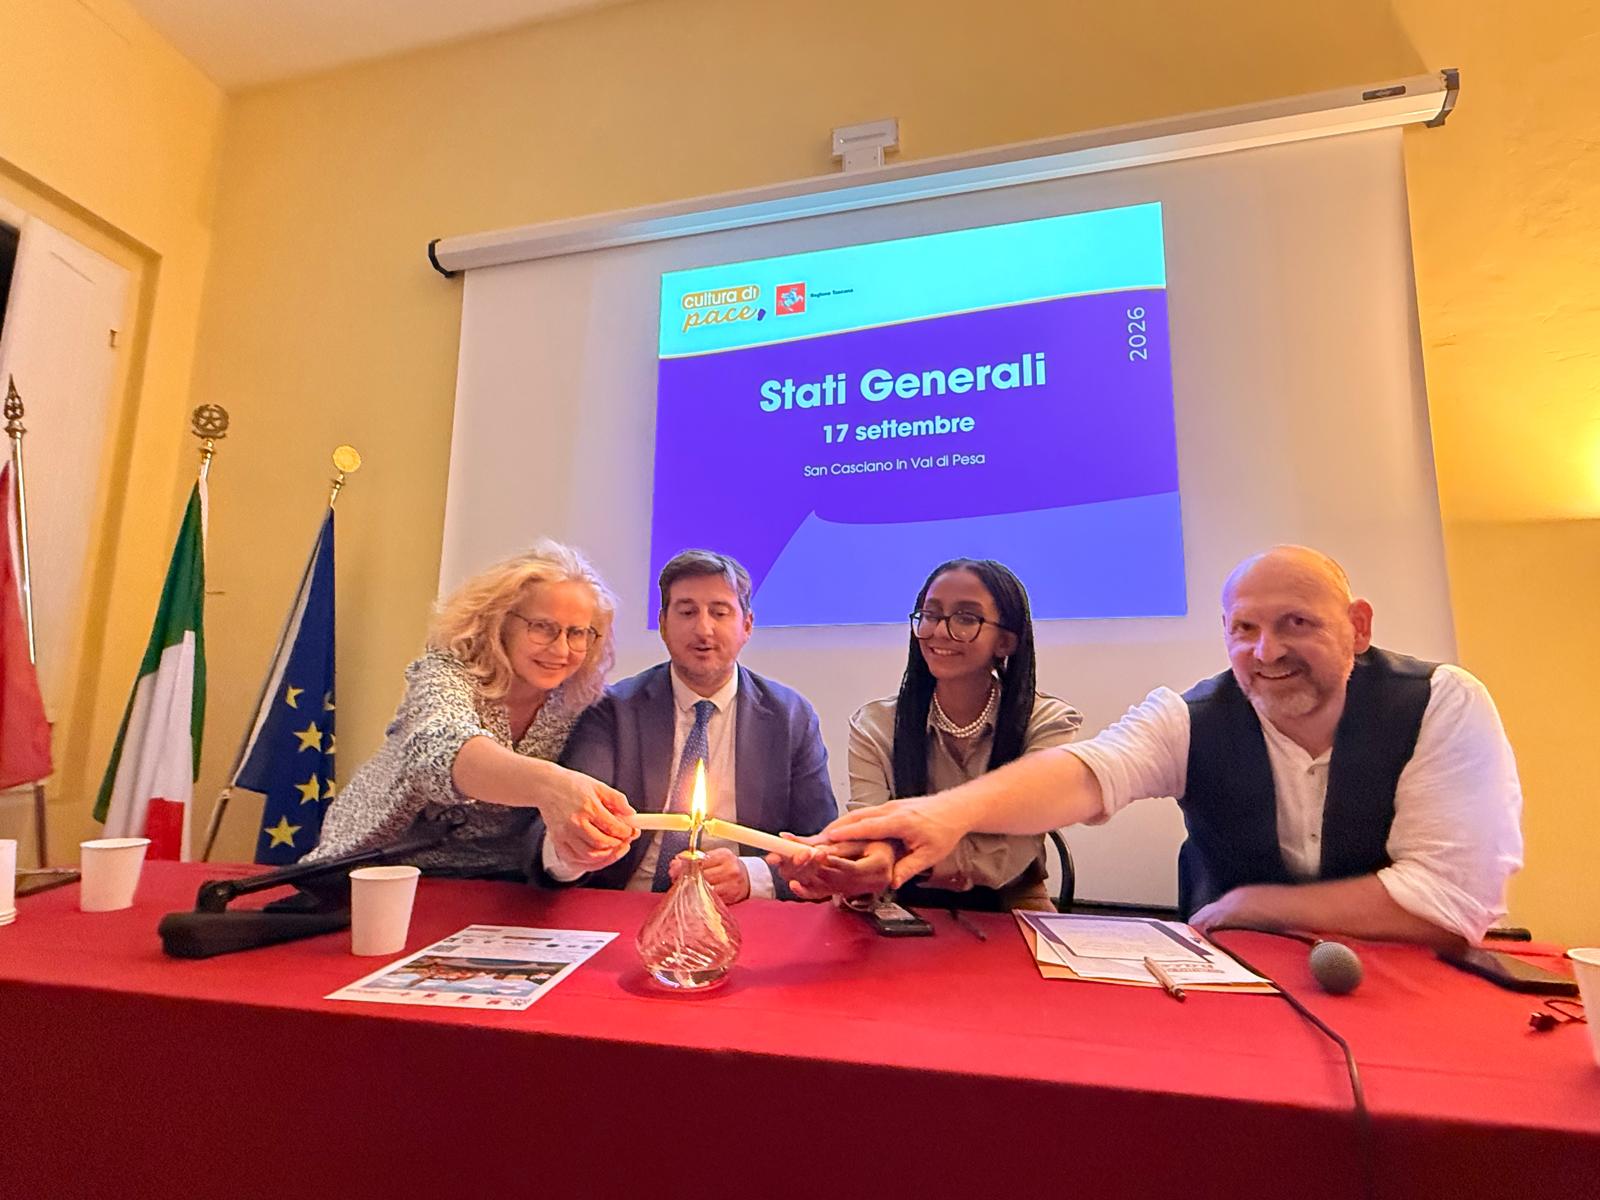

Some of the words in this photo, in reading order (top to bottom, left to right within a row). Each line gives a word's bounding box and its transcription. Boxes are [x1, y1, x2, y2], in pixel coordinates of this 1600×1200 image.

[683, 290, 737, 309] cultura
[741, 286, 757, 301] di
[1127, 306, 1148, 362] 2026
[759, 373, 847, 412] Stati
[860, 352, 1046, 402] Generali
[823, 424, 849, 443] 17
[855, 416, 976, 441] settembre
[804, 465, 828, 477] San
[830, 459, 893, 475] Casciano
[910, 456, 933, 469] Val
[936, 455, 949, 467] di
[952, 454, 986, 466] Pesa
